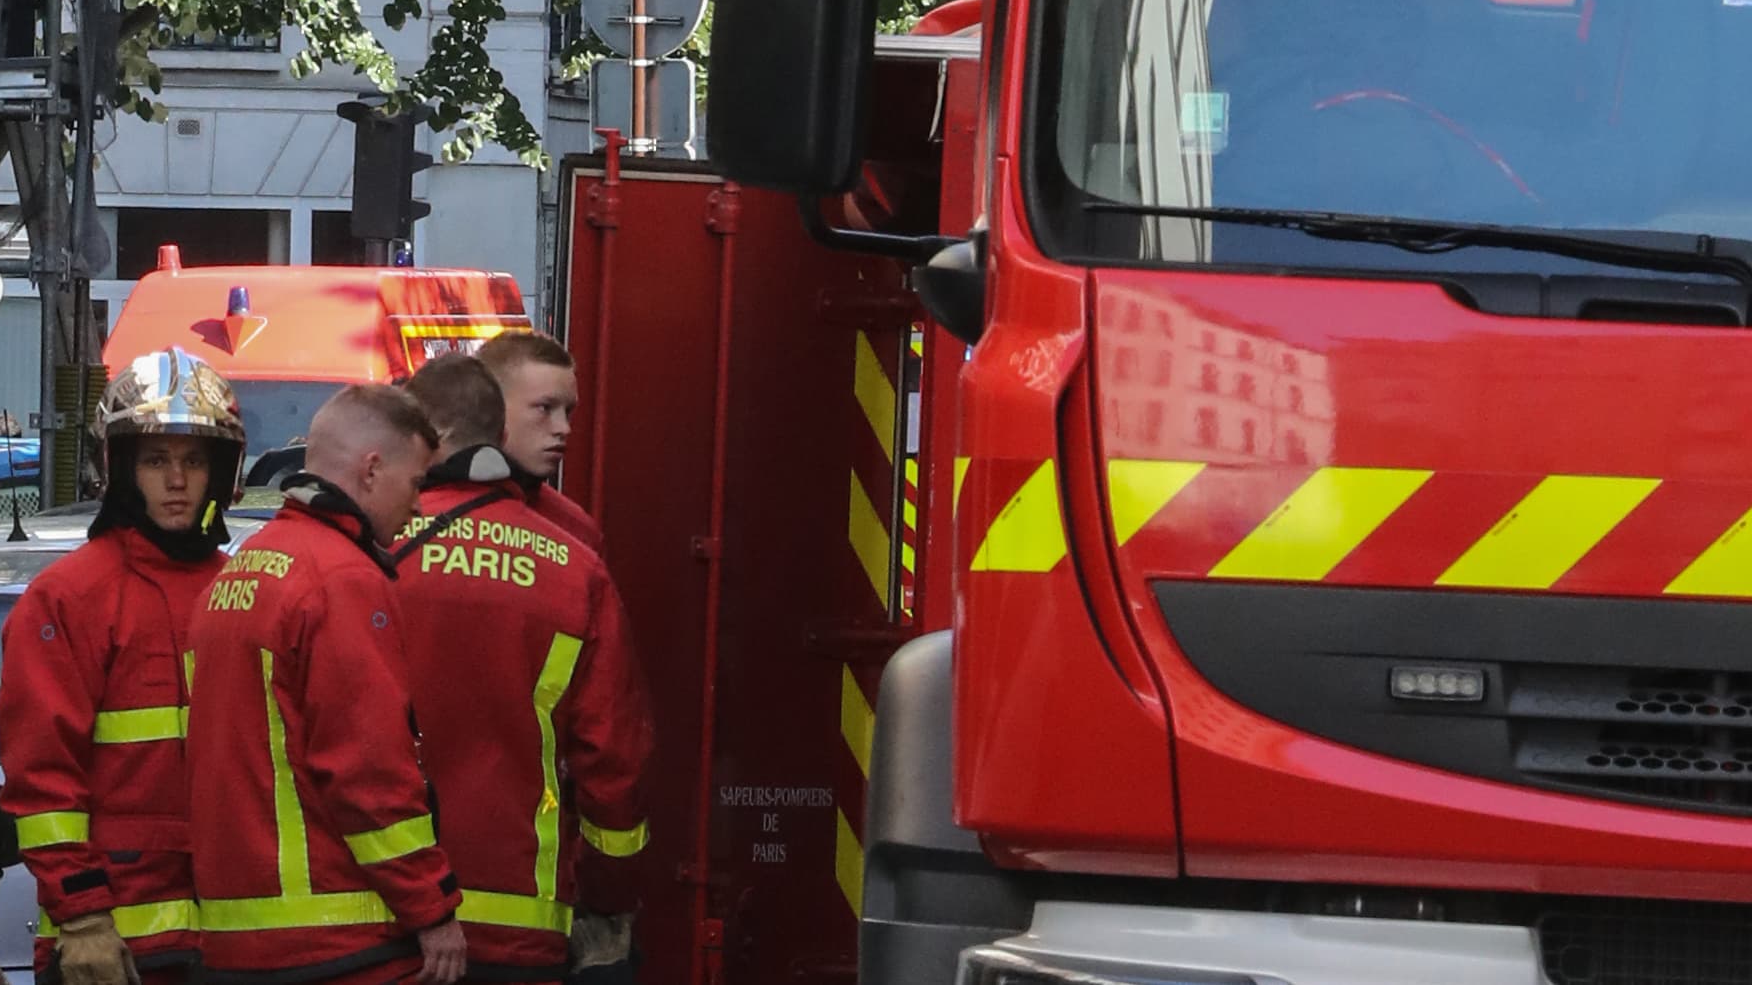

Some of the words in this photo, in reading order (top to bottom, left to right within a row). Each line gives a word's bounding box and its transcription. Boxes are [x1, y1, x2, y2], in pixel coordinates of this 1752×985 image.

[478, 520, 569, 566] POMPIERS
[421, 544, 536, 587] PARIS
[207, 578, 259, 611] PARIS
[762, 813, 779, 832] DE
[752, 843, 787, 863] PARIS
